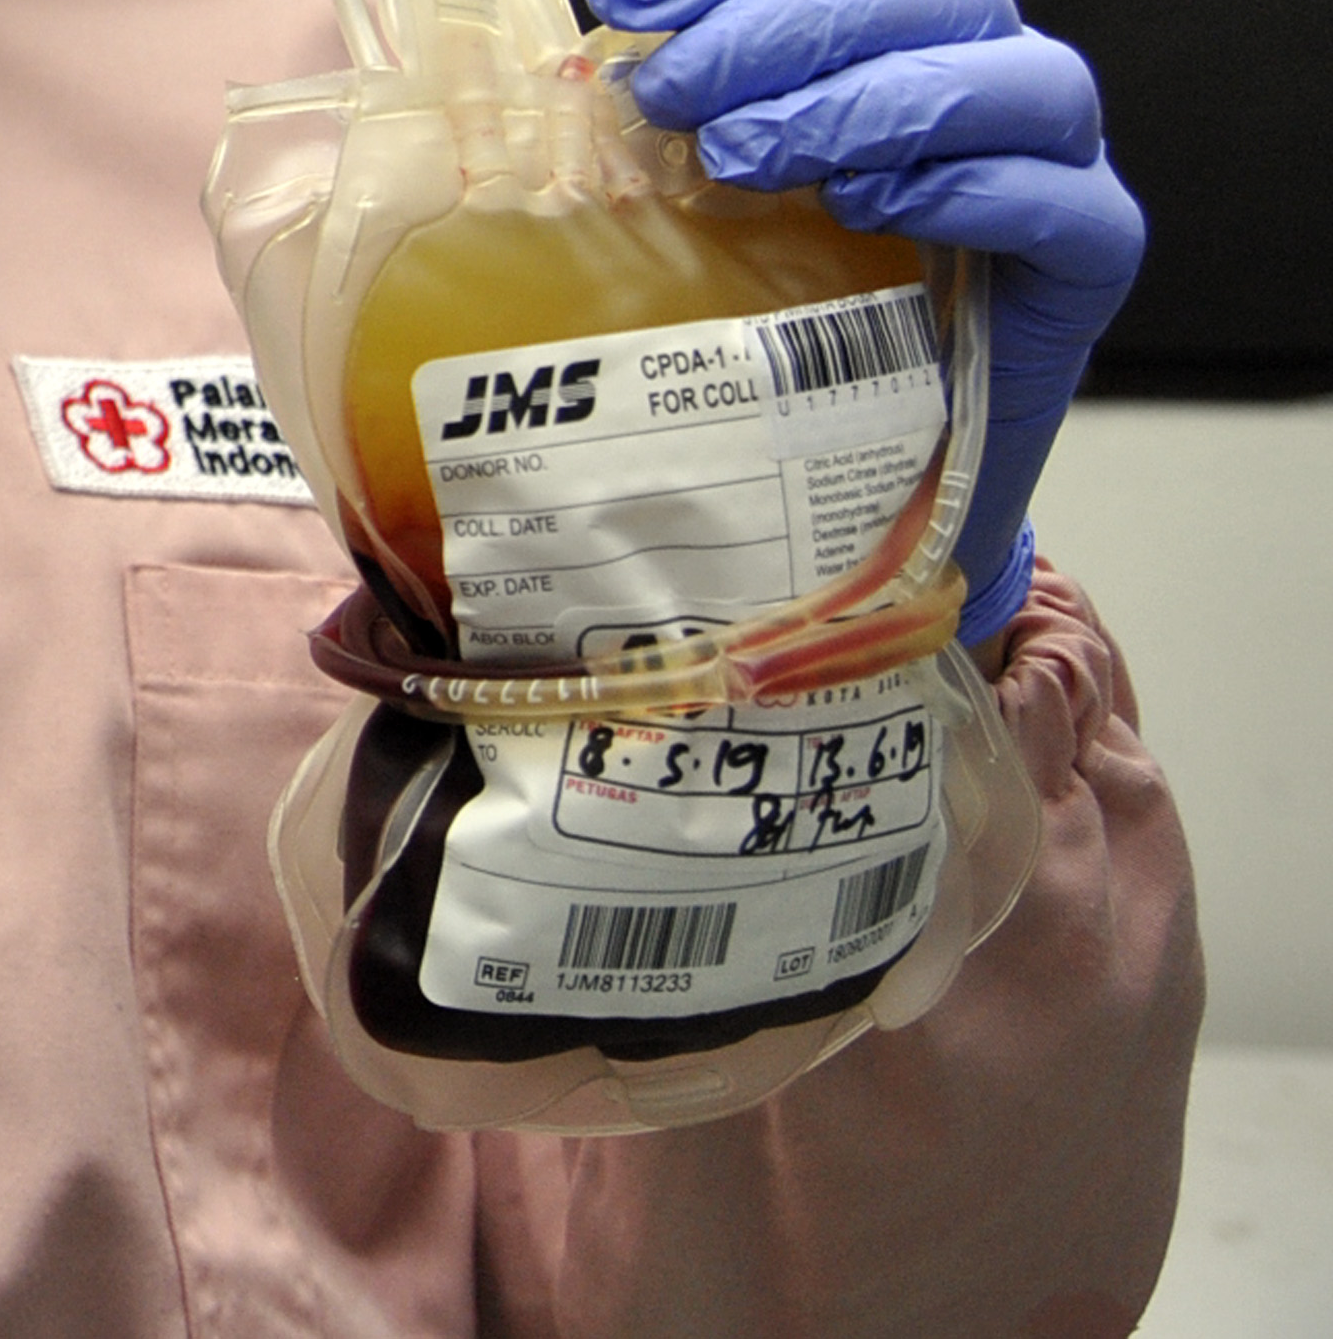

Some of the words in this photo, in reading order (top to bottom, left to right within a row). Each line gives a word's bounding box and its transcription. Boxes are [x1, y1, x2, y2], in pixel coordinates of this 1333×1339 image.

[641, 347, 725, 380] CPDA-1
[441, 359, 601, 441] JMS
[649, 388, 698, 415] FOR
[440, 457, 509, 483] DONOR
[514, 453, 547, 472] NO.
[454, 519, 502, 537] COLL.
[510, 515, 558, 535] DATE
[459, 580, 499, 597] EXP.
[505, 575, 552, 595] DATE
[616, 727, 665, 744] AFTAP
[477, 745, 497, 761] TO
[565, 778, 639, 804] PETUGAS
[481, 964, 524, 983] REF
[781, 955, 809, 974] LOT
[556, 972, 692, 993] 1JM8113233
